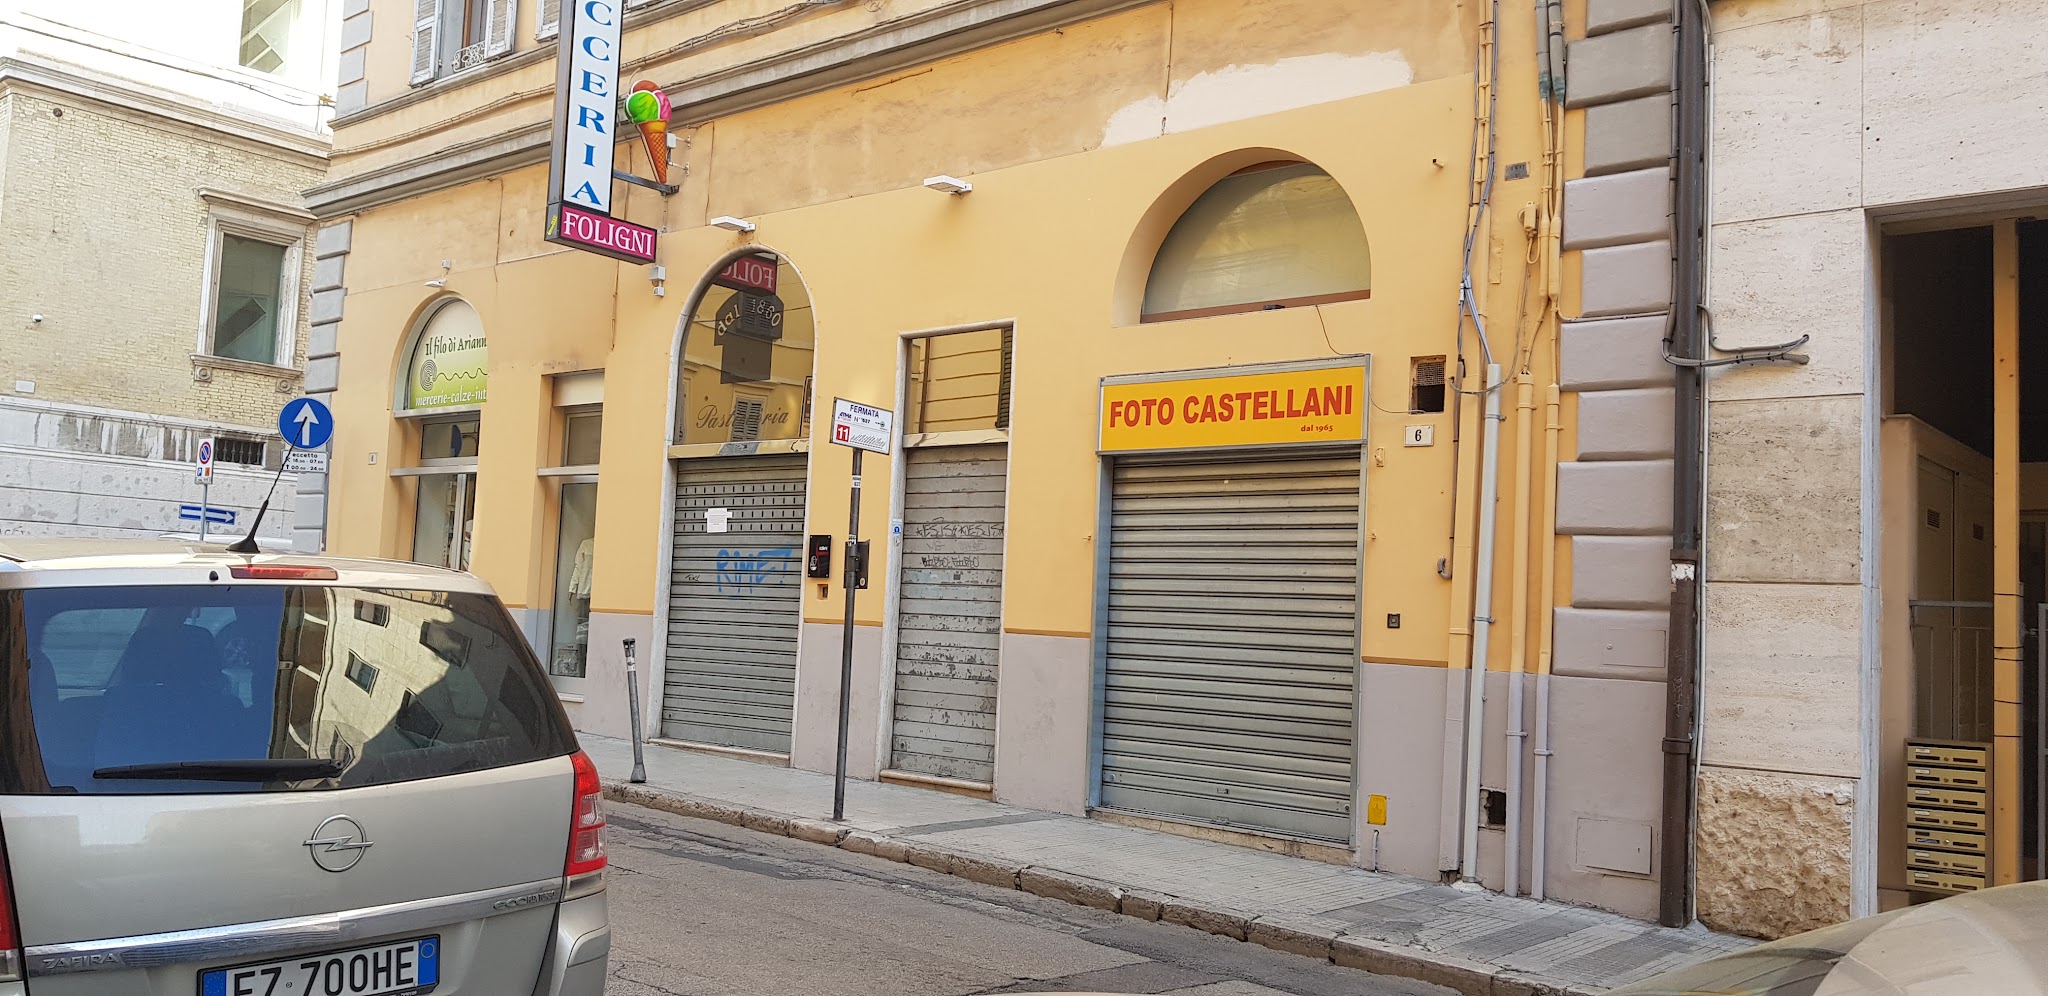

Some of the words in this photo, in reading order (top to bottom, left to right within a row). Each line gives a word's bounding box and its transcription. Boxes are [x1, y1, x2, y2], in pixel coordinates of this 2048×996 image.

[564, 211, 654, 257] FOLIGNI
[717, 304, 740, 337] dal
[425, 336, 433, 356] Il
[433, 335, 447, 360] filo
[448, 336, 456, 353] di
[696, 404, 789, 429] Pastieria
[849, 404, 880, 419] FERMATA
[1109, 397, 1175, 428] FOTO
[1183, 385, 1353, 425] CASTELLANI
[838, 427, 850, 441] 11
[1300, 424, 1314, 433] dal
[1315, 424, 1334, 433] 1965
[1415, 429, 1423, 442] 6
[41, 952, 121, 970] ZAFIRA
